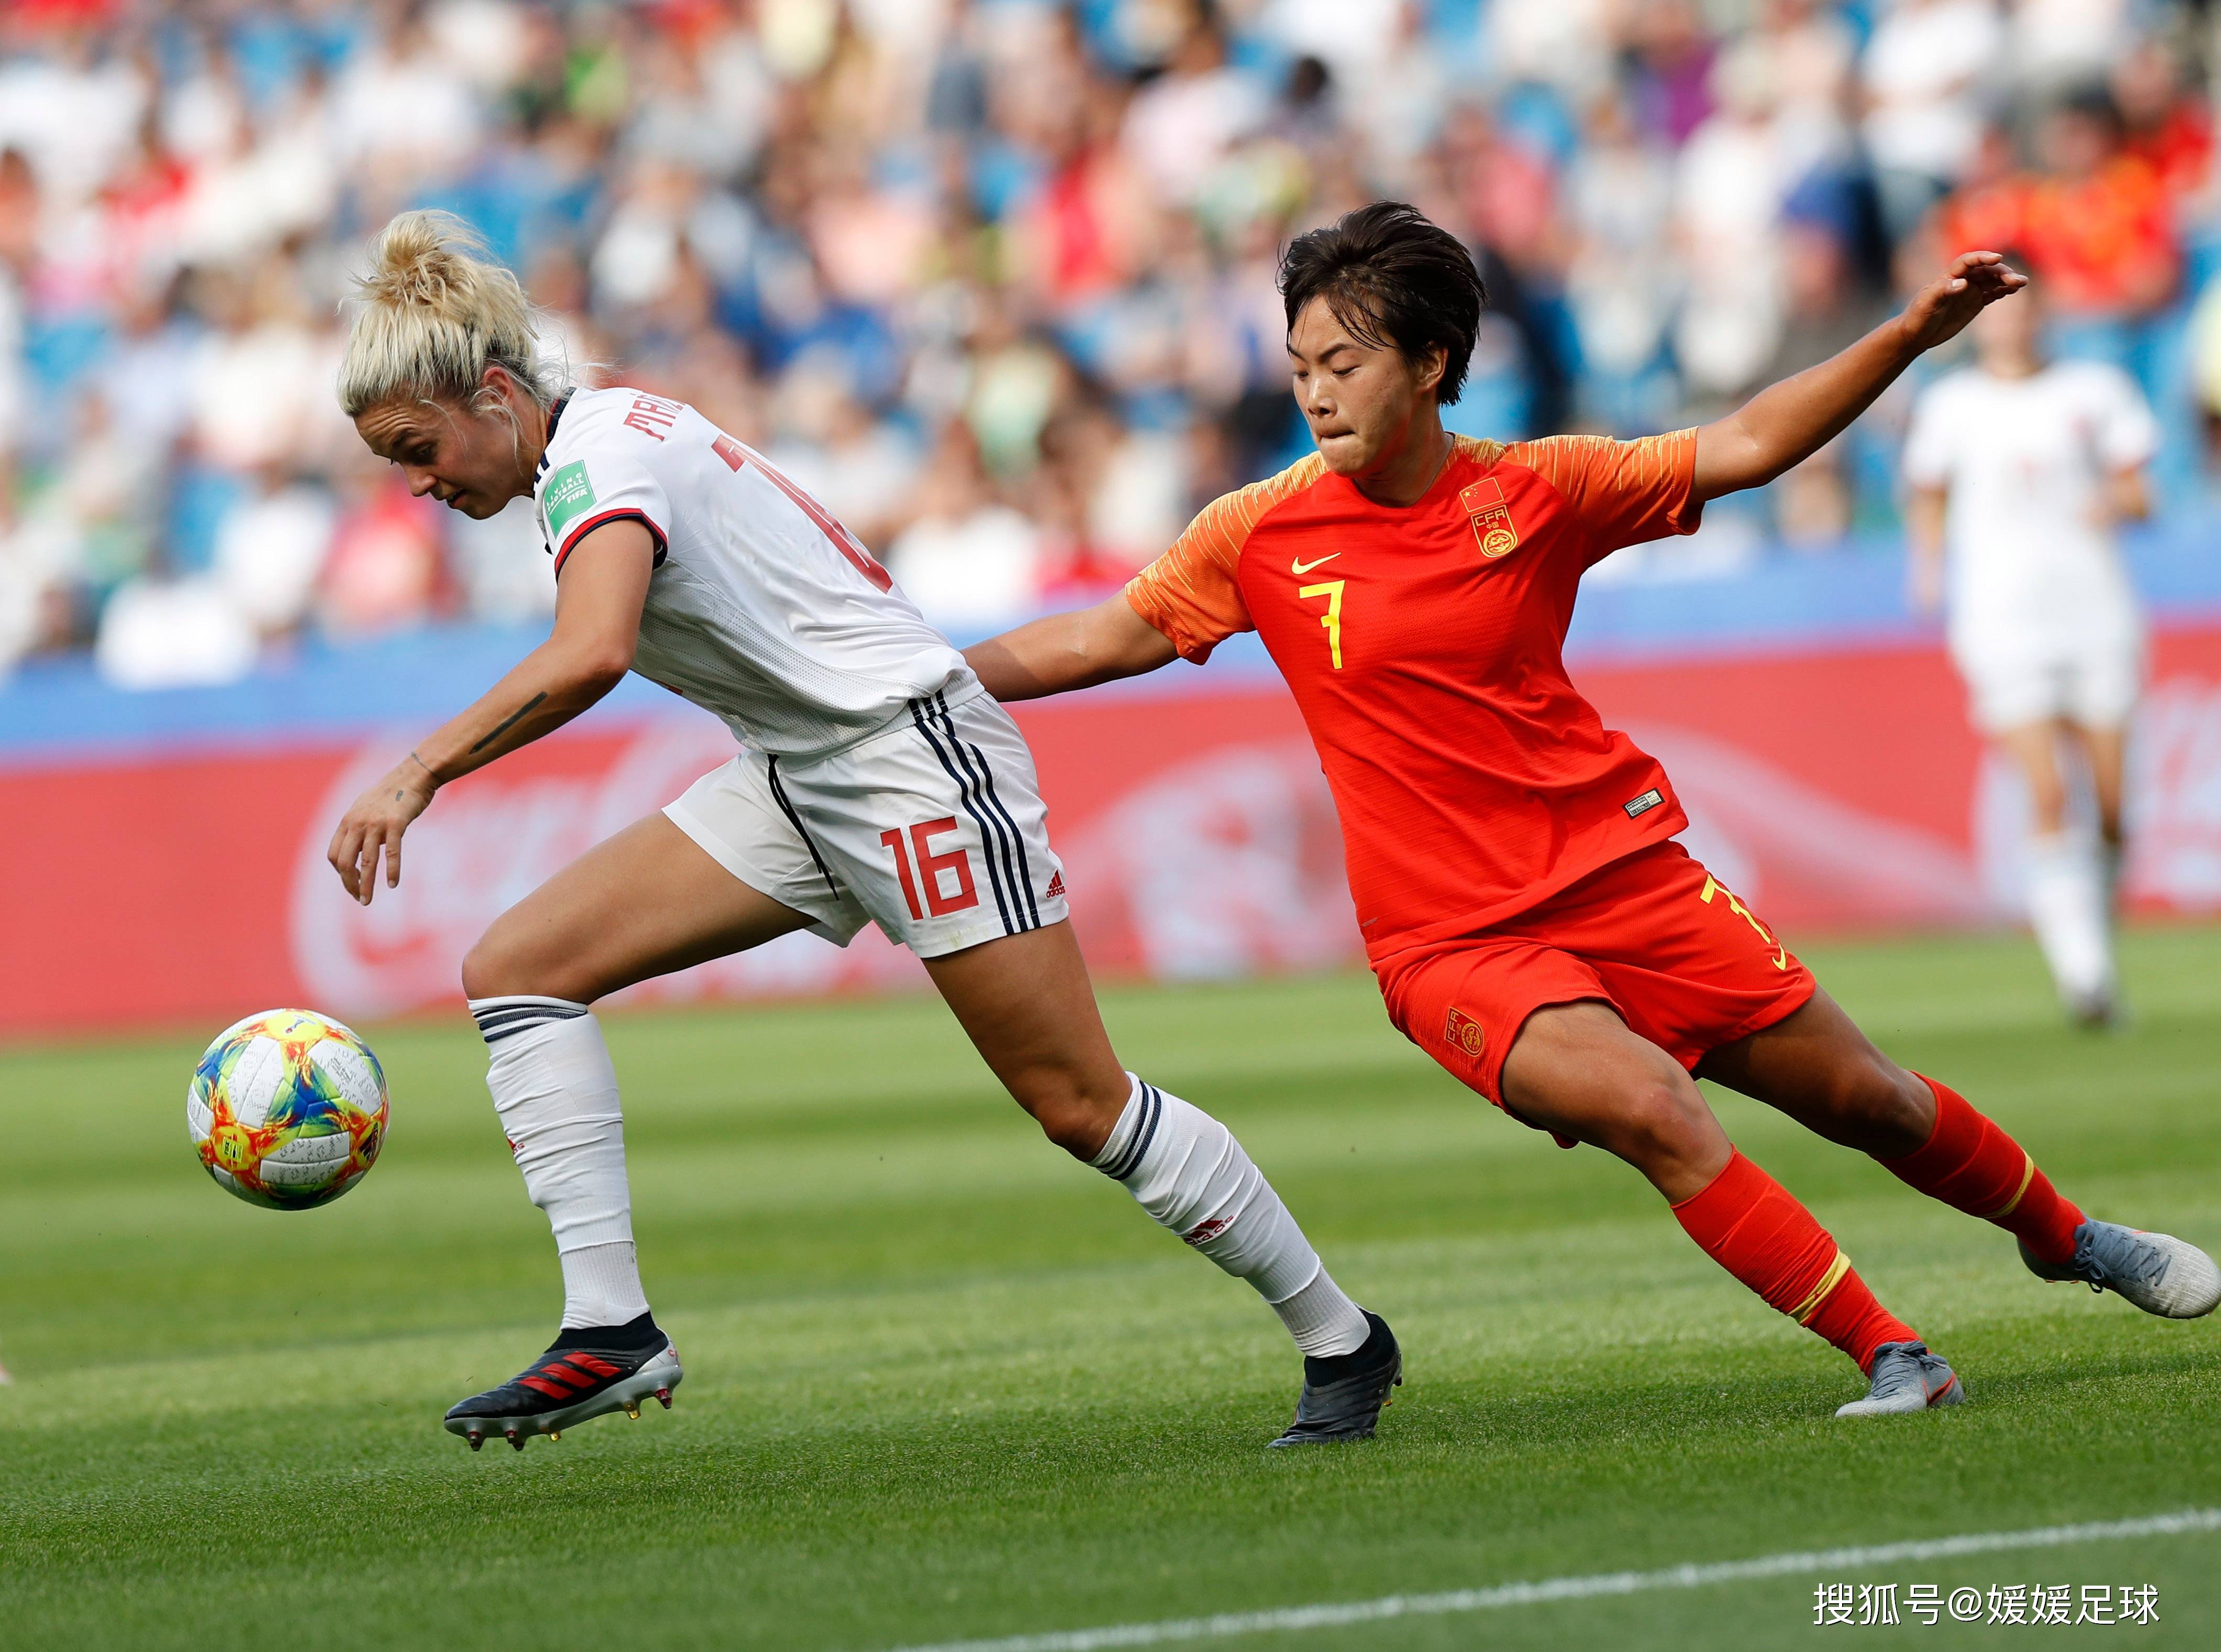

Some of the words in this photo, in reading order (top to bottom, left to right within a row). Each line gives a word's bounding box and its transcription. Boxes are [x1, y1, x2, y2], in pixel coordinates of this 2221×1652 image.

[547, 472, 582, 507] LIVING
[547, 478, 584, 511] FOOTBALL
[567, 488, 588, 504] FIFA
[1474, 509, 1506, 527] CFA
[1299, 579, 1345, 670] 7
[880, 816, 979, 921] 16
[1046, 885, 1065, 898] adidas
[1700, 873, 1771, 945] 7
[1447, 1011, 1459, 1042] CFA
